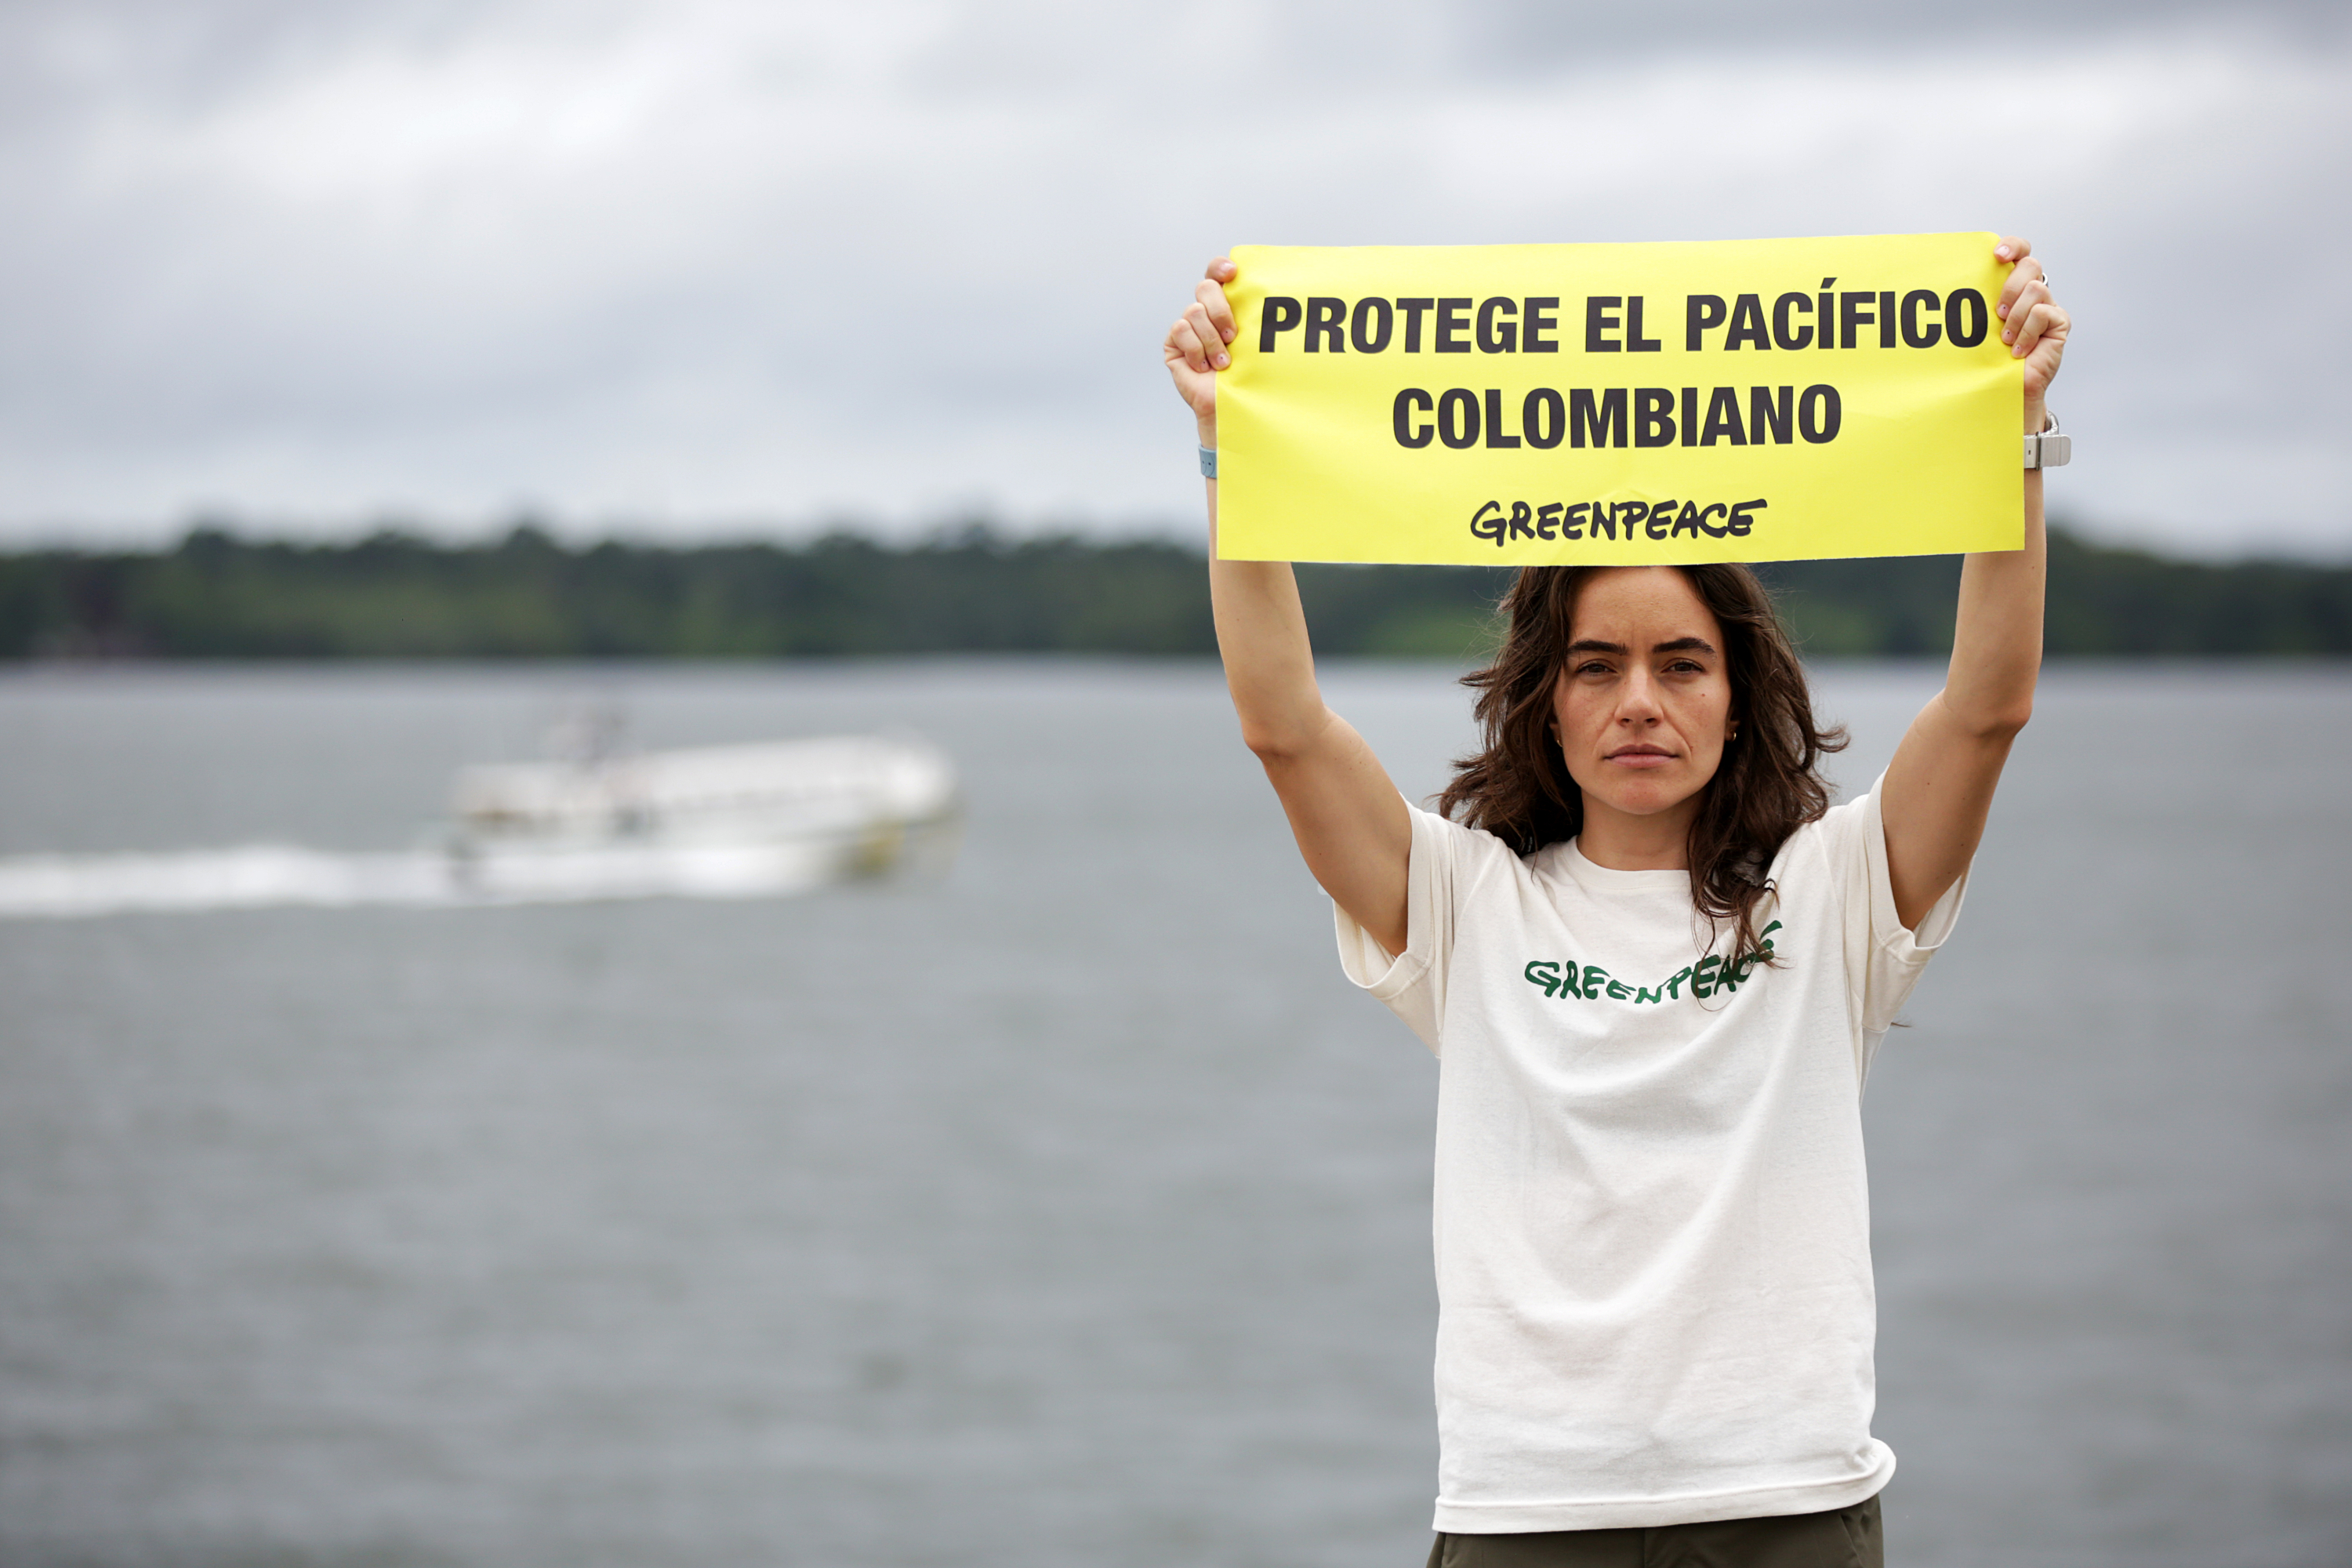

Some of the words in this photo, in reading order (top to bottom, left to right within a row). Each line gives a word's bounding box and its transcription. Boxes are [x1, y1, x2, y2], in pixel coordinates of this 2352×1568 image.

[1259, 296, 1559, 354] PROTEGE
[1585, 296, 1661, 353] EL
[1686, 277, 1988, 351] PACÍFICO
[1392, 383, 1842, 449] COLOMBIANO
[1470, 498, 1768, 547] GREENPEACE
